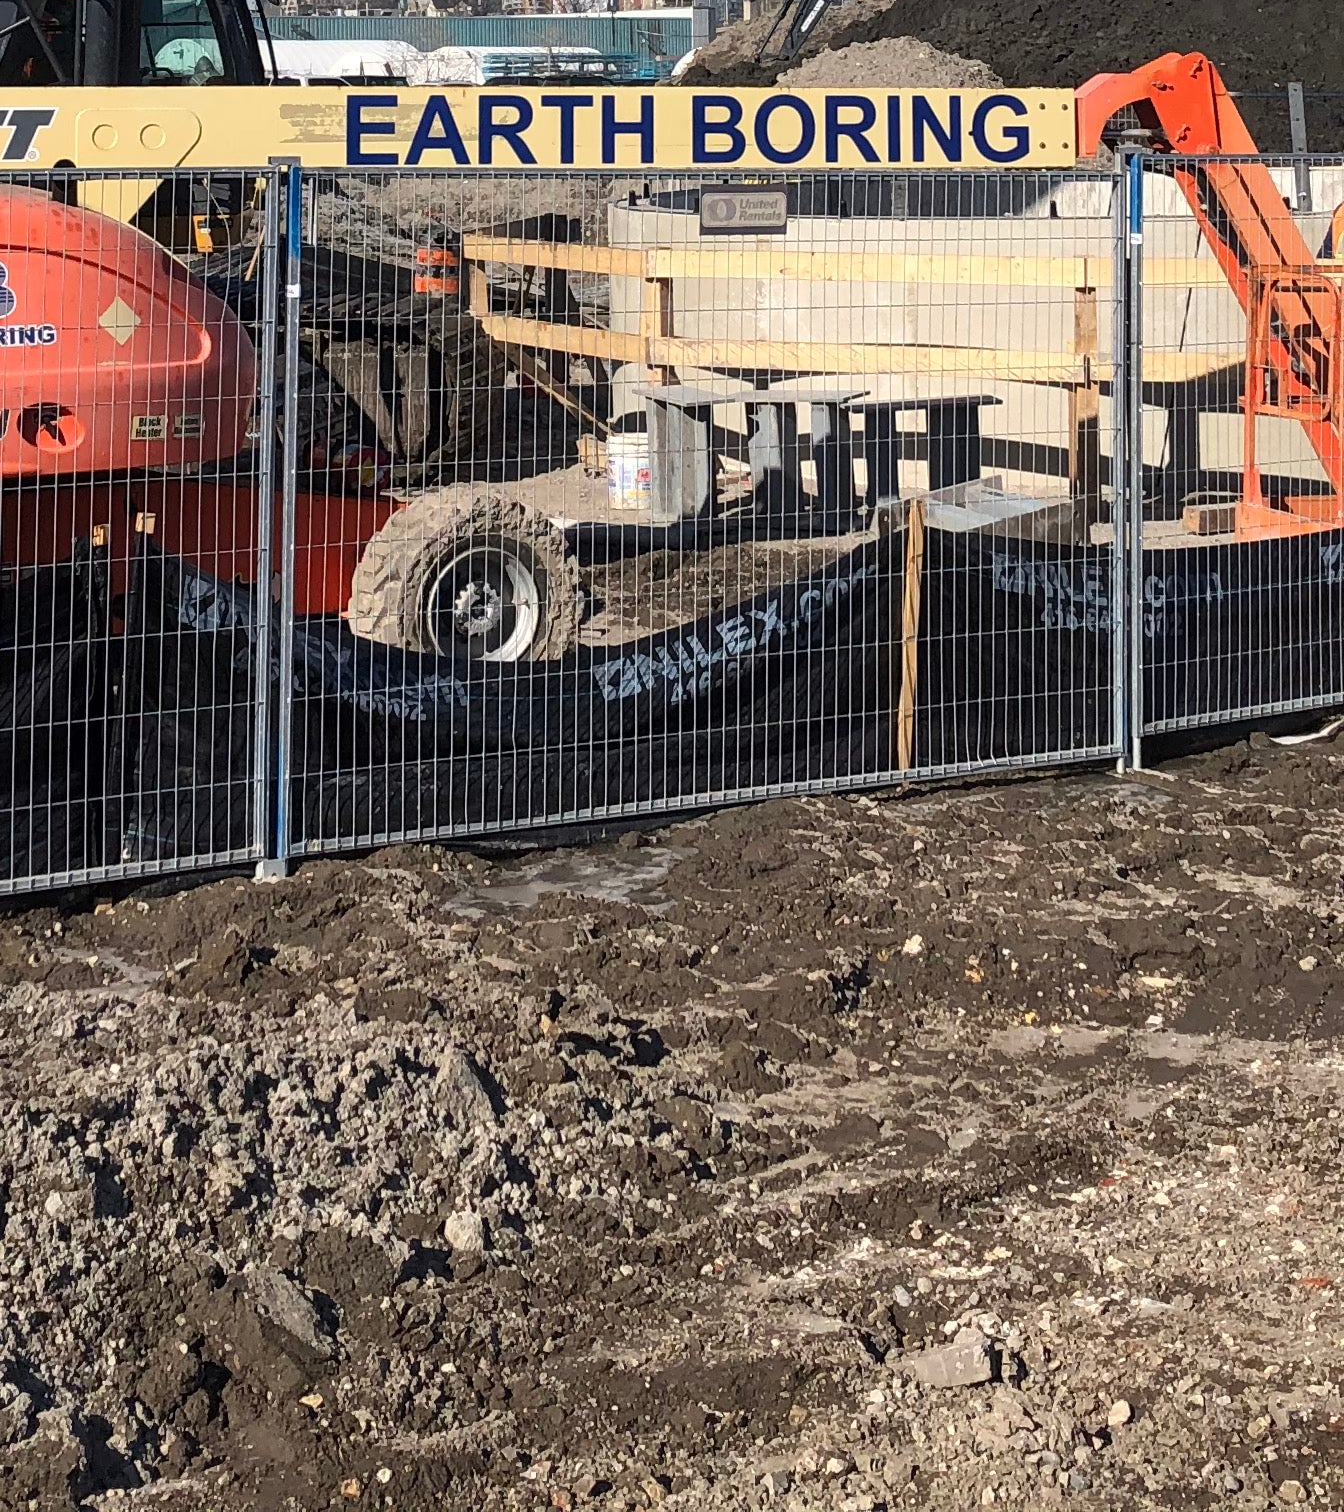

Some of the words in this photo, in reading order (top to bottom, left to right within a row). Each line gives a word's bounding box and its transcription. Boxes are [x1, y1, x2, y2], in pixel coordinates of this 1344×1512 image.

[346, 95, 655, 165] EARTH
[692, 95, 1030, 164] BORING
[739, 198, 778, 210] United
[739, 210, 782, 222] Rentals
